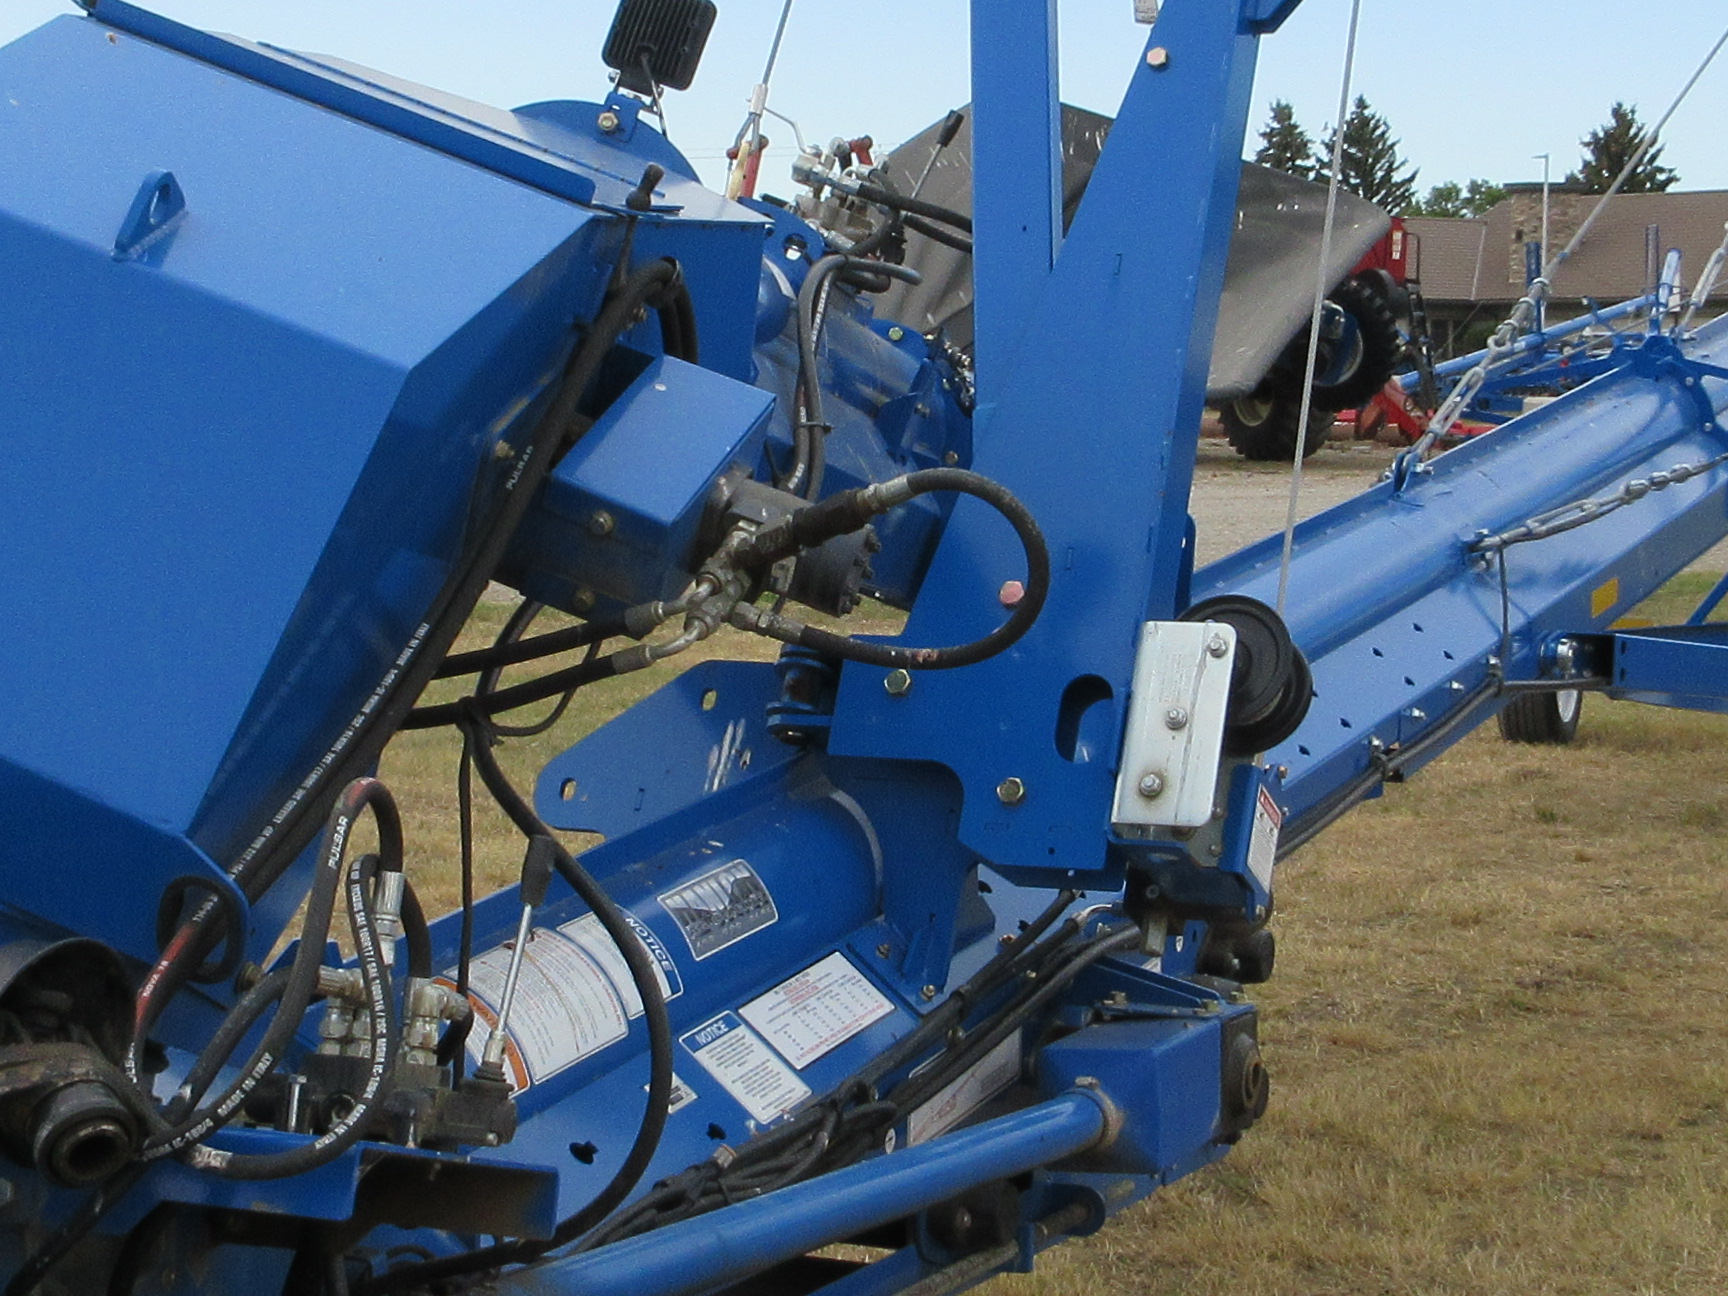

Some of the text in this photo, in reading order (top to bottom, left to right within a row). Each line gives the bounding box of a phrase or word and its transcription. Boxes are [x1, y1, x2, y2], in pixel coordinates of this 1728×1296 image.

[328, 815, 349, 870] PULSAR
[625, 917, 674, 972] NOTICE
[694, 1019, 730, 1046] NOTICE
[217, 1089, 245, 1117] MADE
[242, 1078, 256, 1092] IN
[251, 1052, 274, 1079] ITALY
